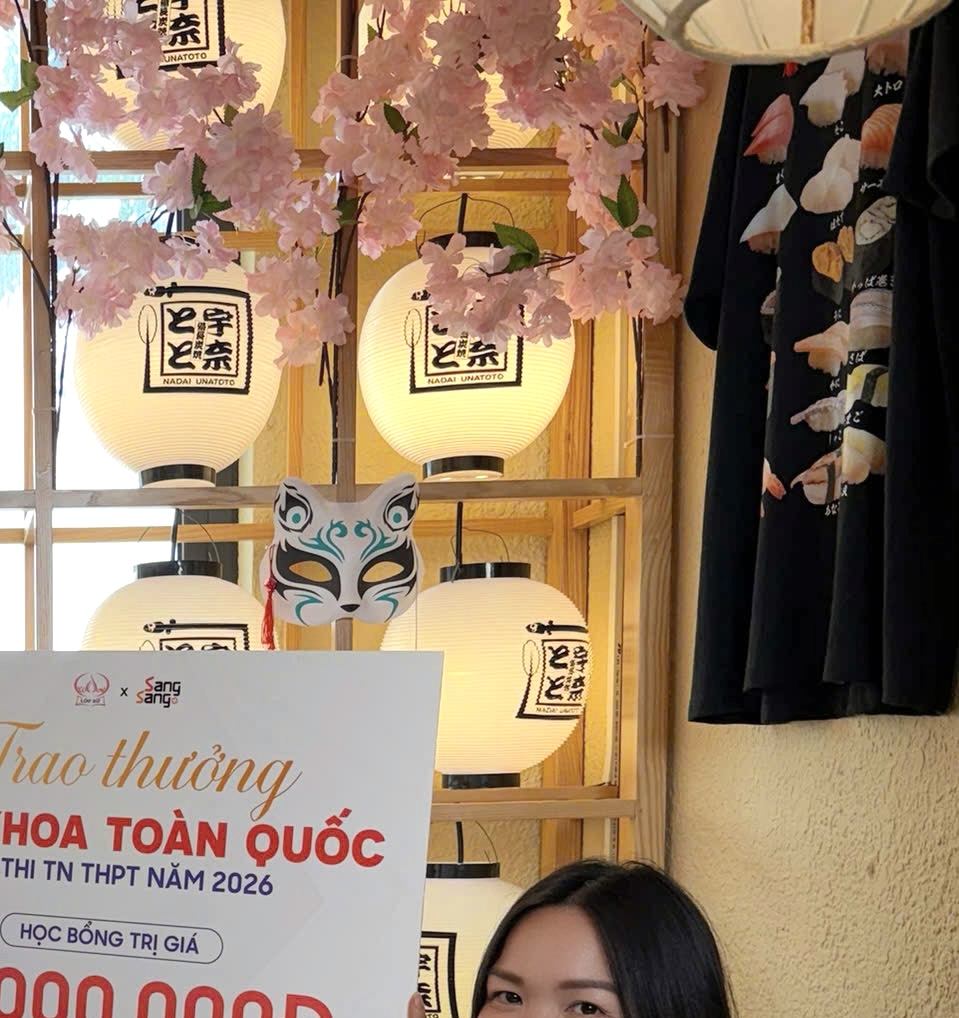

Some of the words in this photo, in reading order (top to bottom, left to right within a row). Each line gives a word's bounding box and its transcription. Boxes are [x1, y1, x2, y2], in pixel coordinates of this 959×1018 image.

[163, 52, 207, 63] UNATOTO
[195, 378, 236, 386] UNATOTO
[461, 373, 504, 382] UNATOTO
[144, 676, 181, 696] Sang
[101, 730, 303, 822] thưởng
[106, 808, 228, 858] TOÀN
[245, 807, 386, 868] QUỐC
[1, 857, 35, 879] THI
[43, 860, 74, 882] TN
[81, 862, 140, 887] THPT
[147, 862, 205, 892] NĂM
[212, 870, 274, 896] 2026
[20, 922, 62, 946] HỌC
[67, 920, 124, 948] BỔNG
[130, 932, 159, 956] TRỊ
[164, 932, 199, 955] GIÁ
